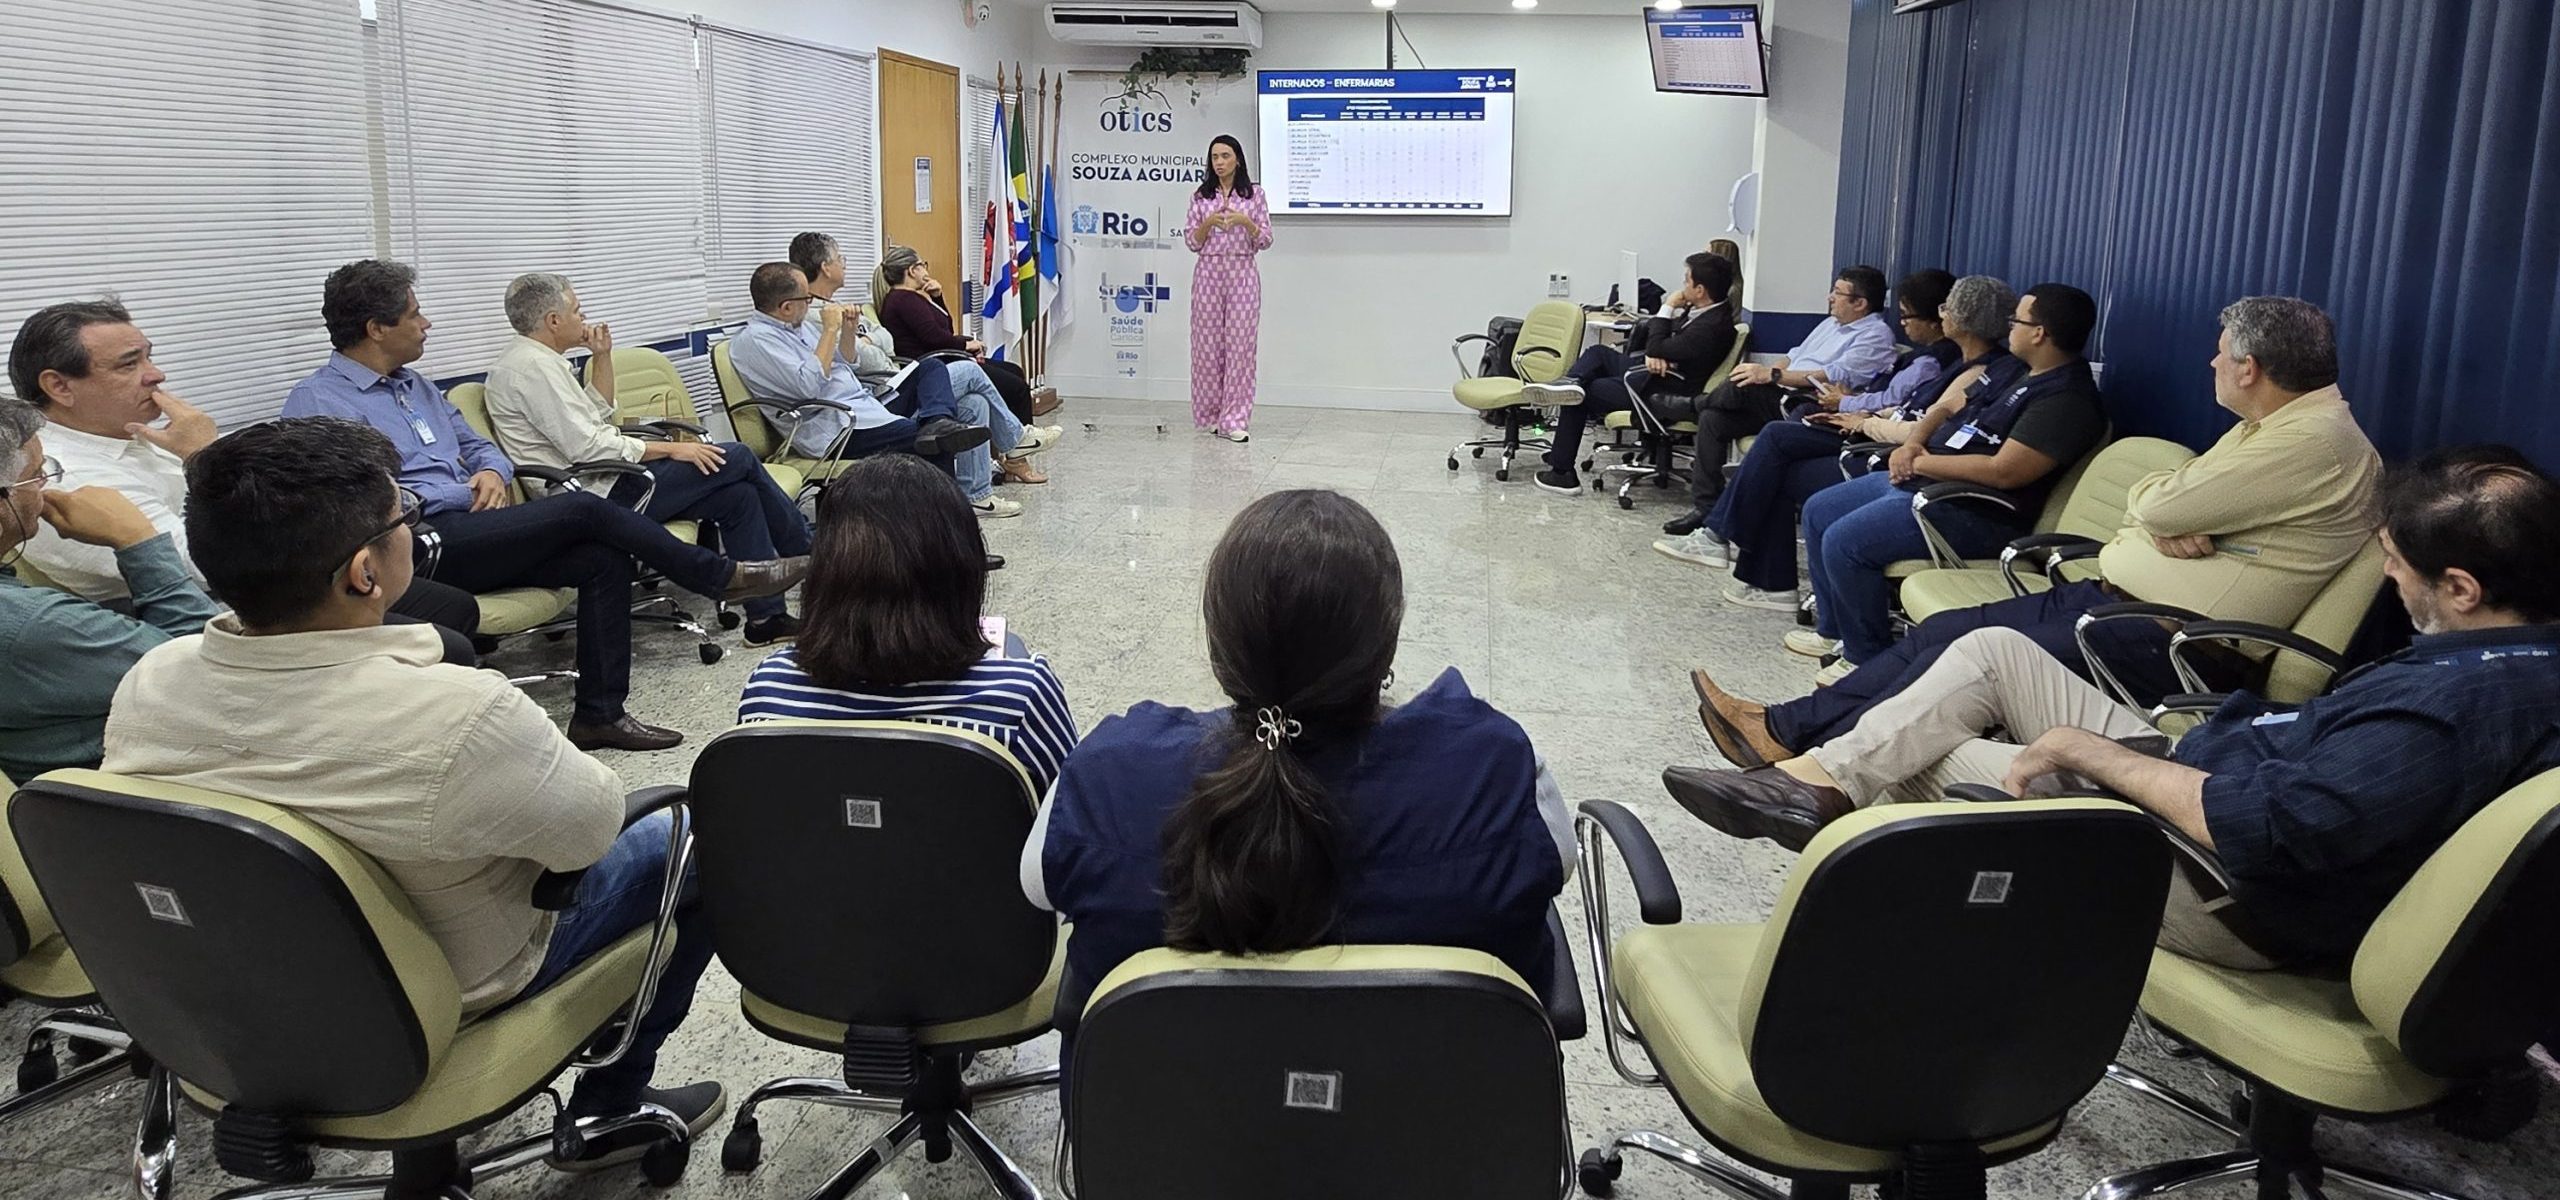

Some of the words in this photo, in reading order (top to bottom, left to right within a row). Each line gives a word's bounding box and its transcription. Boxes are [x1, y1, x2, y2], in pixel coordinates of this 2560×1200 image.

[1269, 79, 1325, 88] INTERNADOS
[1334, 78, 1395, 88] ENFERMARIAS
[1100, 106, 1172, 132] otics
[1071, 153, 1138, 165] COMPLEXO
[1142, 155, 1206, 166] MUNICIPAL
[1072, 166, 1132, 181] SOUZA
[1136, 168, 1205, 183] AGUIAR
[1102, 212, 1148, 236] Rio
[1111, 316, 1144, 326] Saúde
[1110, 326, 1144, 334] Pública
[1125, 352, 1139, 360] Rio
